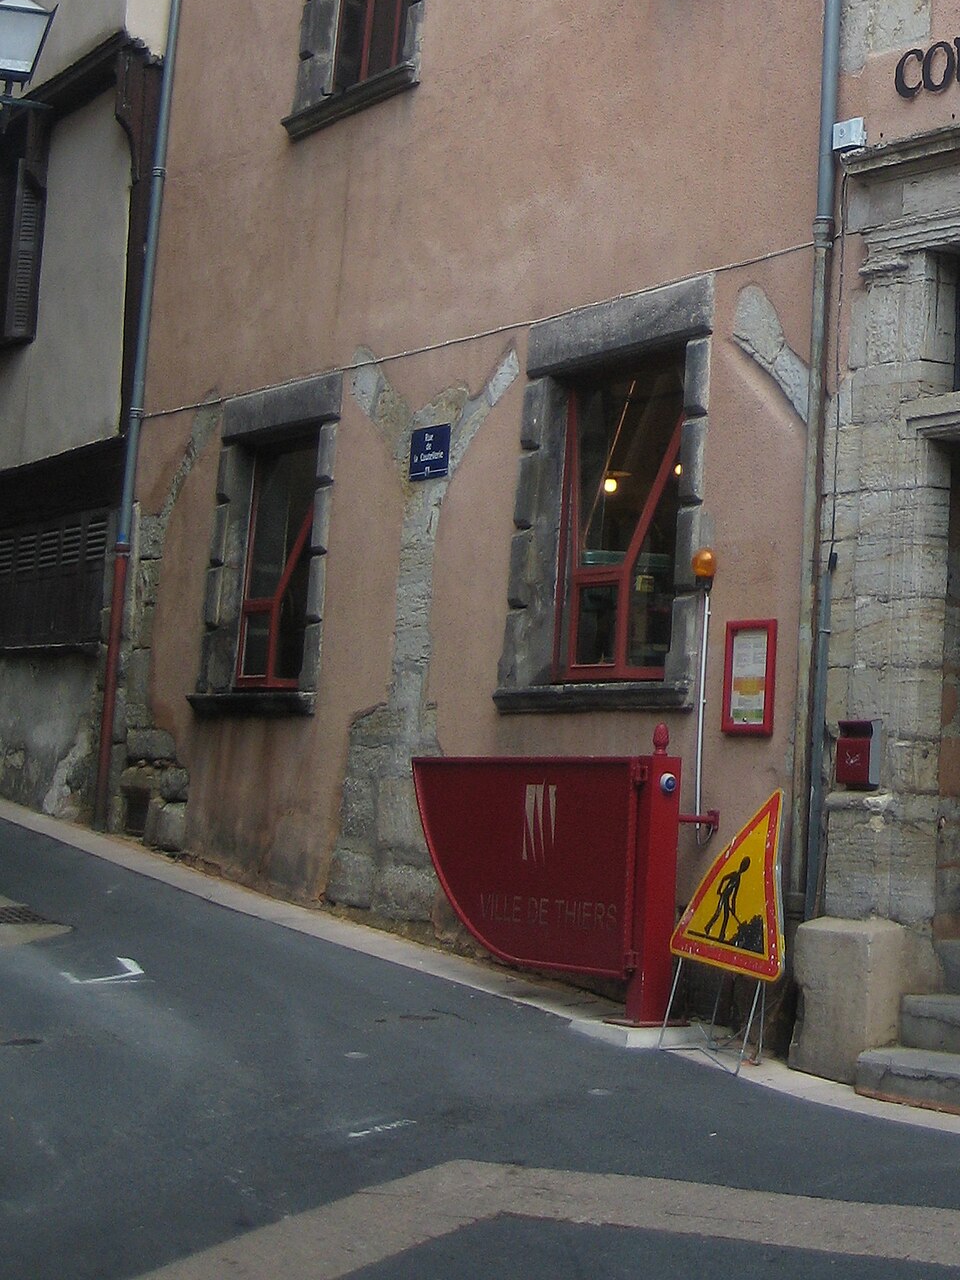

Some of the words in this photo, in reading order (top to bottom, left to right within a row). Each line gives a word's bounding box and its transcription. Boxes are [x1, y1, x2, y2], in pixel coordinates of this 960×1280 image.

[424, 433, 434, 442] Rue
[480, 891, 522, 923] VILLE
[527, 896, 550, 926] DE
[555, 899, 618, 931] THIERS
